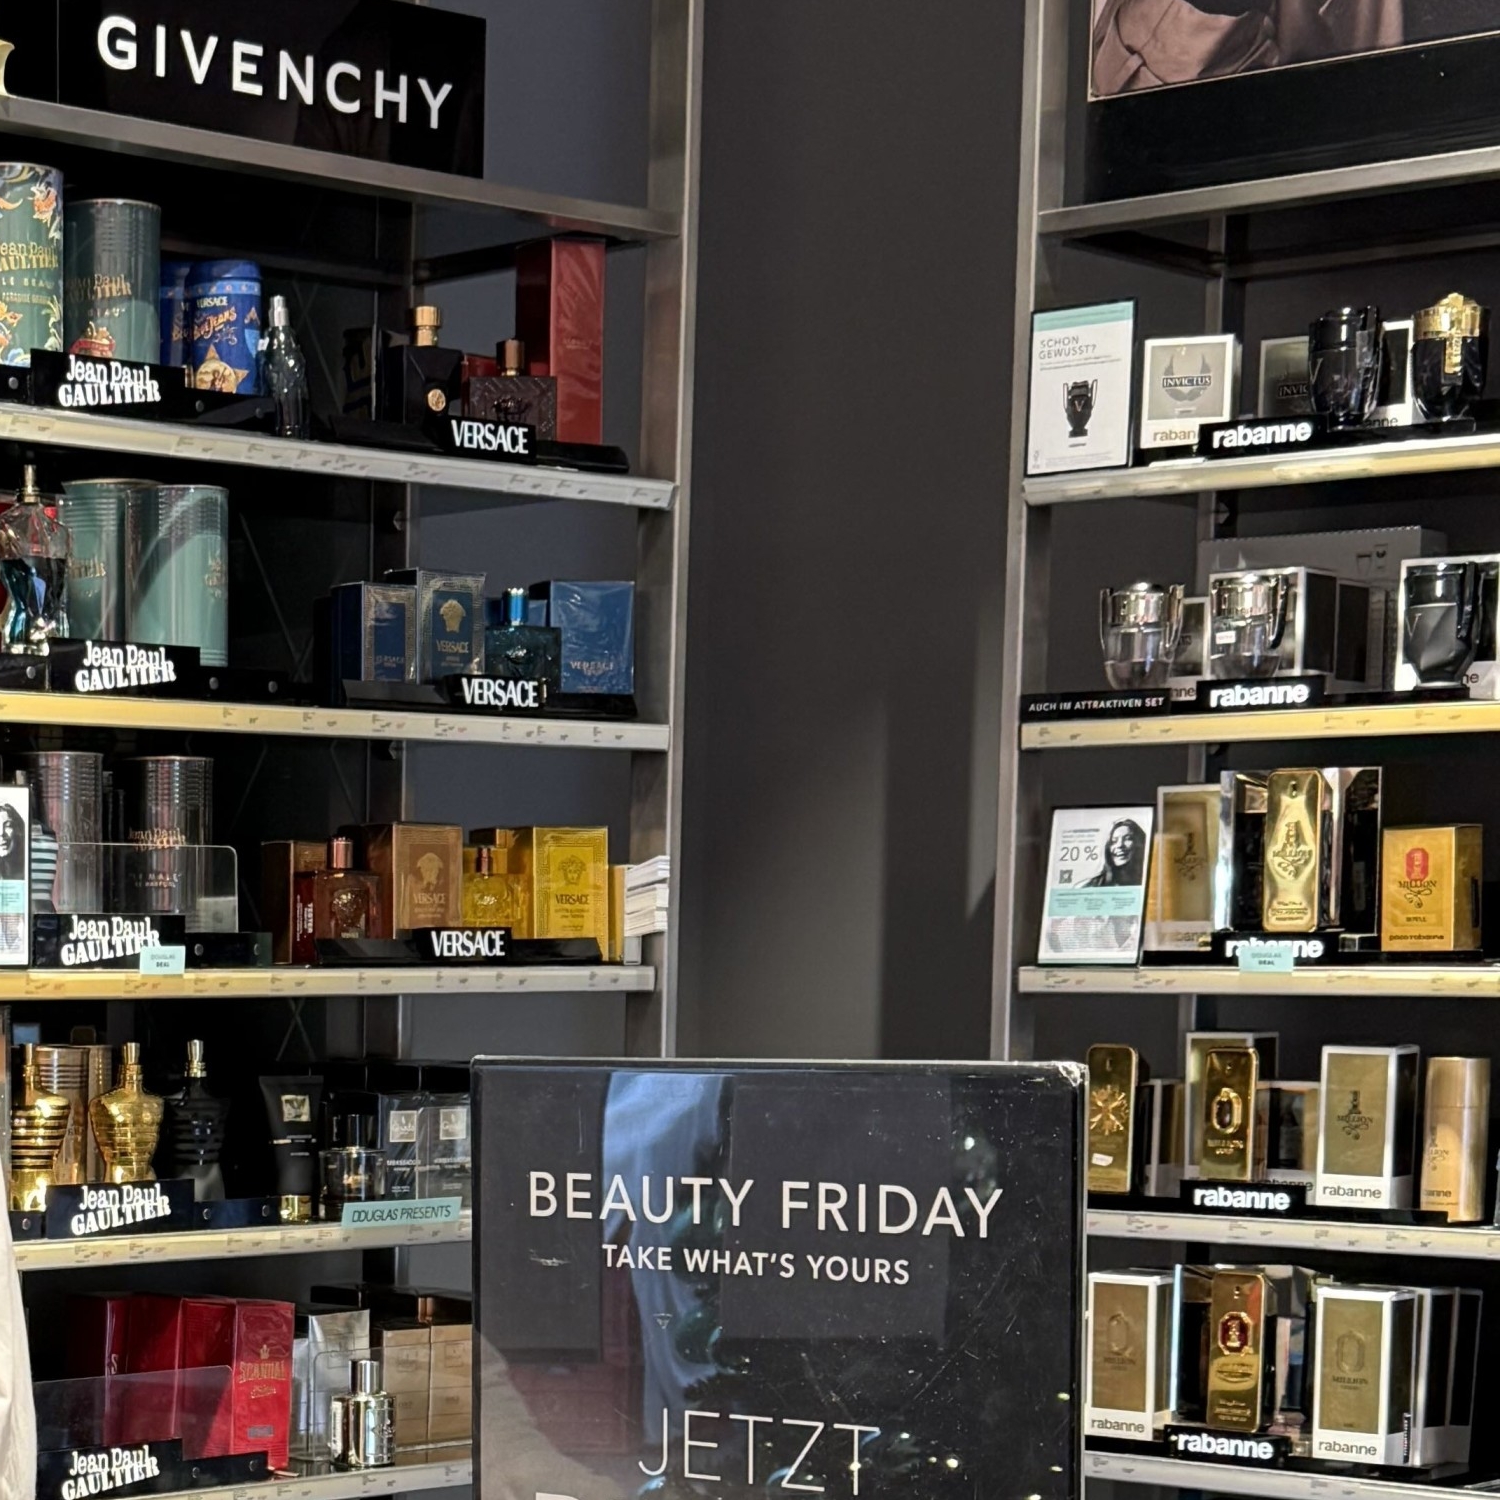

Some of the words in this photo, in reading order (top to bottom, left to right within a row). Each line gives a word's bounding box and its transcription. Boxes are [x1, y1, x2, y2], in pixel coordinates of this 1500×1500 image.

[96, 14, 454, 131] GIVENCHY
[1039, 344, 1096, 360] GEWUSST?
[1040, 335, 1079, 349] SCHON
[66, 354, 108, 385] Jean
[109, 360, 151, 386] Paul
[1162, 376, 1211, 387] INVICTUS
[58, 379, 161, 408] GAULTIER
[449, 417, 530, 456] VERSACE
[1213, 422, 1312, 449] rabanne
[83, 641, 126, 669] Jean
[126, 644, 167, 671] Paul
[436, 640, 469, 653] VERSACE
[75, 660, 177, 692] GAULTIER
[569, 661, 614, 671] VERSACE
[462, 677, 539, 708] VERSACE
[1029, 701, 1057, 712] AUCH
[1059, 701, 1071, 711] IM
[1074, 698, 1140, 710] ATTRAKTIVEN
[1145, 697, 1164, 707] SET
[1210, 685, 1309, 707] rabanne
[1059, 846, 1080, 862] 20
[1084, 846, 1098, 861] %
[1398, 879, 1437, 888] MILLION
[413, 893, 446, 904] VERSACE
[555, 894, 589, 905] VERSACE
[68, 915, 109, 942] Jean
[111, 917, 152, 940] Paul
[306, 902, 314, 934] TESTER
[61, 929, 160, 966] GAULTIER
[431, 931, 505, 957] VERSACE
[1337, 1114, 1374, 1125] MILLION
[79, 1185, 122, 1210] Jean
[122, 1182, 161, 1208] Paul
[1193, 1187, 1290, 1211] rabanne
[1322, 1183, 1382, 1200] rabanne
[71, 1195, 171, 1236] GAULTIER
[352, 1208, 399, 1223] DOUGLAS
[400, 1205, 452, 1220] PRESENTS
[528, 1170, 754, 1228] BEAUTY
[781, 1180, 1004, 1239] FRIDAY
[602, 1244, 673, 1272] TAKE
[684, 1248, 796, 1279] WHAT'S
[806, 1255, 910, 1286] YOURS
[239, 1359, 286, 1383] SCANDAL
[1331, 1376, 1369, 1386] MILLION
[1090, 1418, 1145, 1433] rabanne
[638, 1407, 881, 1496] JETZT
[1177, 1433, 1273, 1459] rabanne
[1318, 1439, 1377, 1456] rabanne
[70, 1451, 110, 1476] Jean
[110, 1446, 151, 1472] Paul
